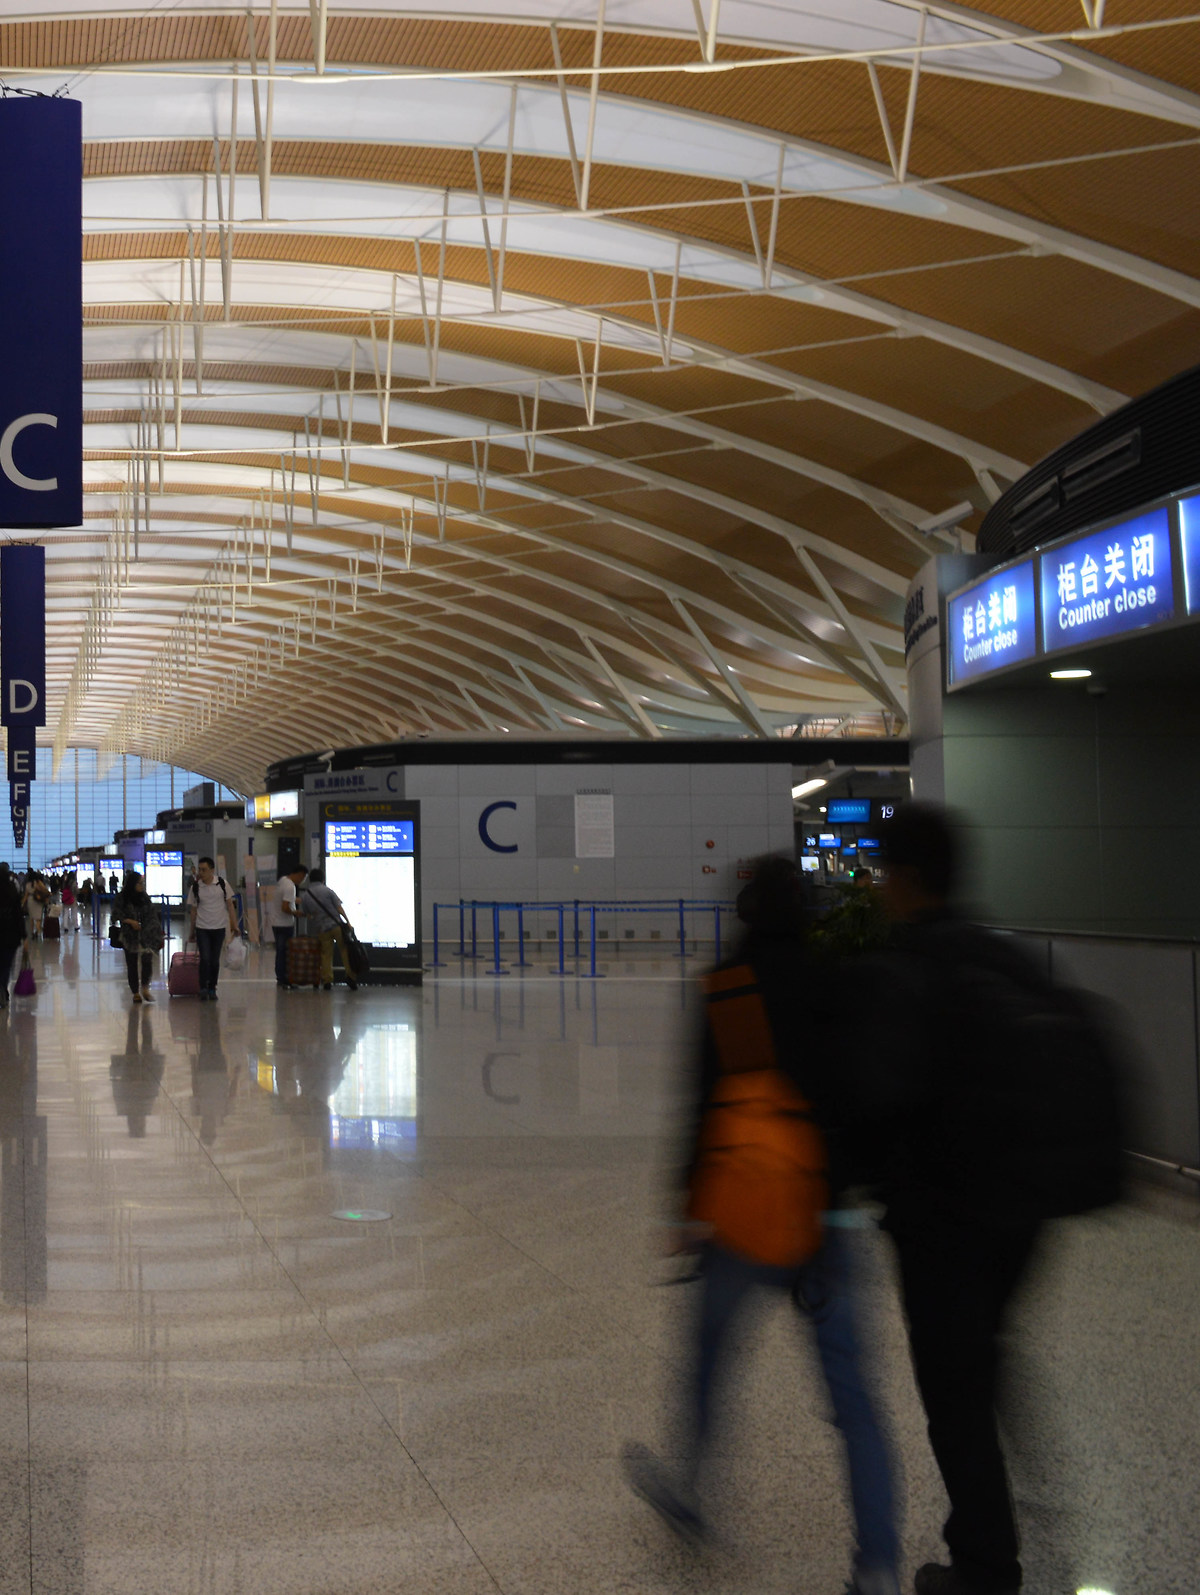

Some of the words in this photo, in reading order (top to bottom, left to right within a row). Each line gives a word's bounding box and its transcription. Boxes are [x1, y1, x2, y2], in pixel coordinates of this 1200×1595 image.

[0, 413, 58, 491] C
[1057, 533, 1155, 605] 柜台关闭
[962, 585, 1018, 642] 柜台关闭
[1058, 597, 1111, 630] Counter
[1114, 585, 1157, 613] close
[963, 638, 993, 664] Counter
[993, 629, 1018, 651] close
[9, 679, 38, 714] D
[13, 750, 30, 773] E
[13, 783, 27, 801] F
[386, 771, 398, 792] C
[13, 806, 25, 817] G
[325, 805, 335, 817] C
[478, 801, 519, 854] C
[881, 805, 894, 819] 19
